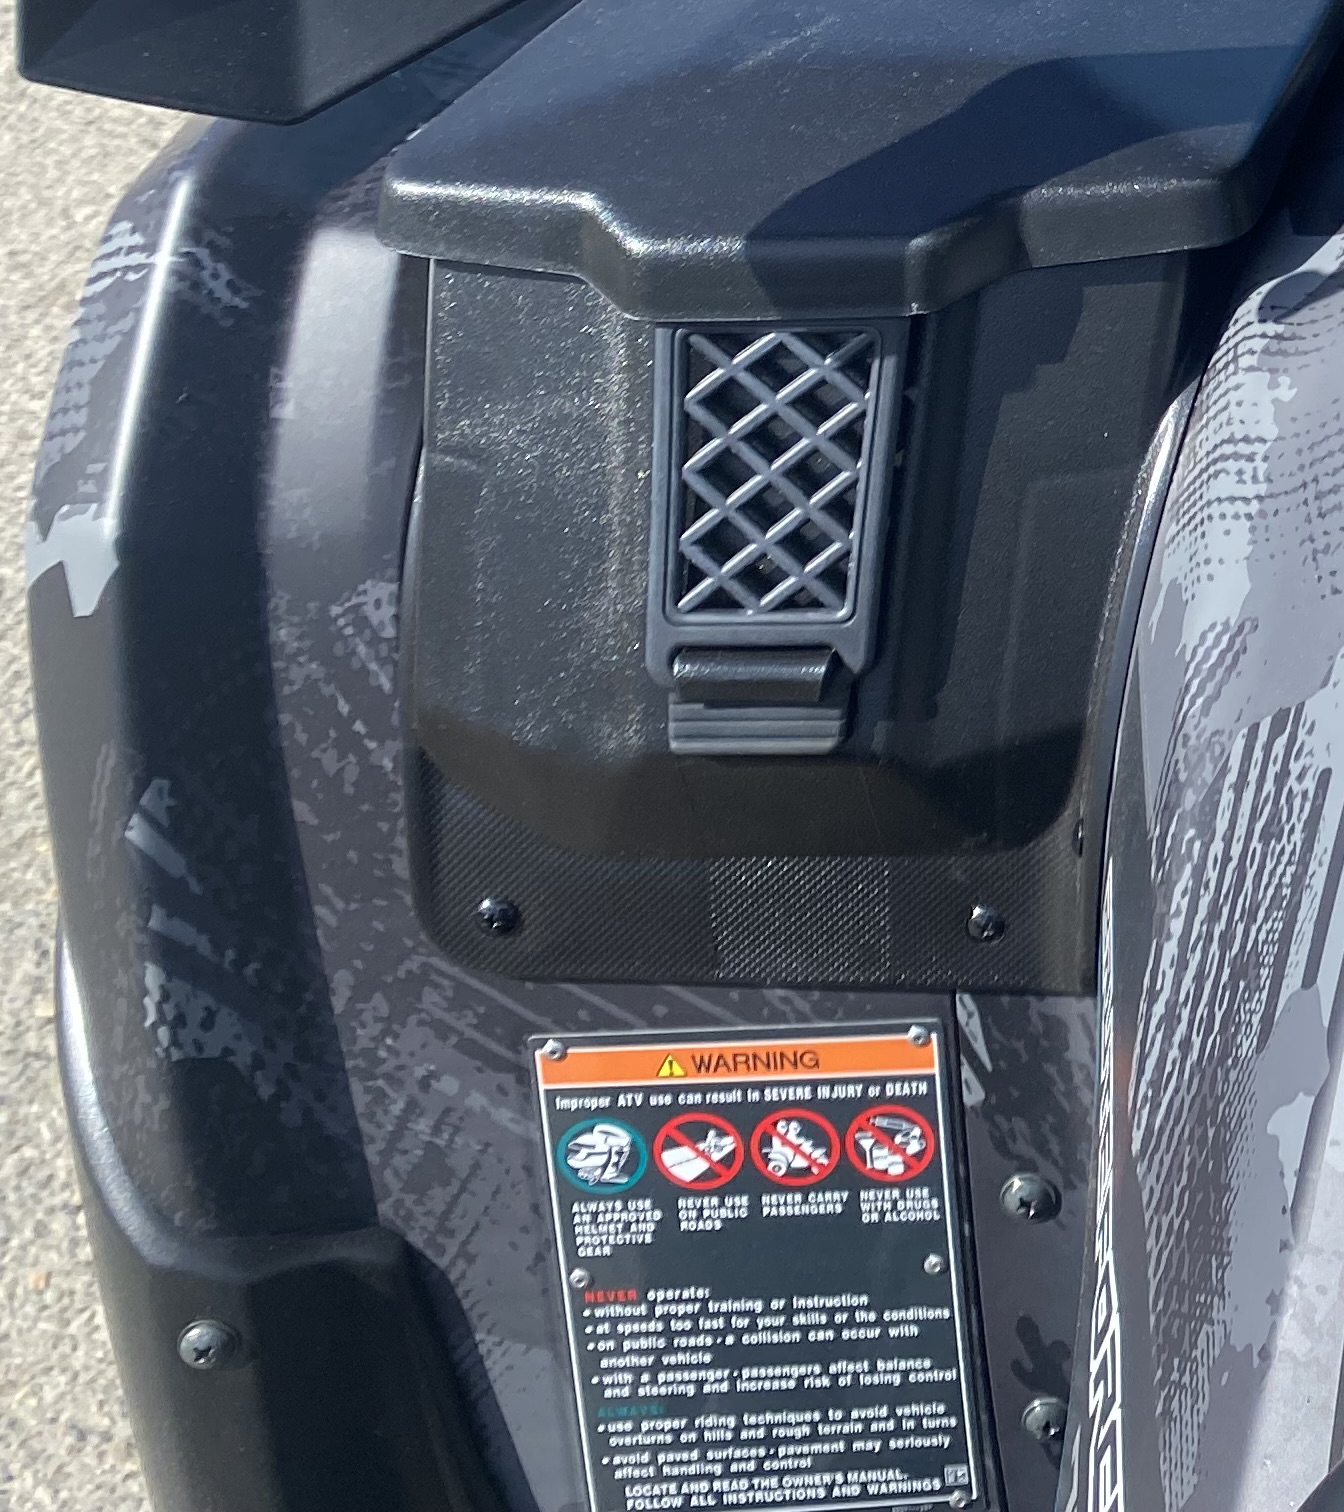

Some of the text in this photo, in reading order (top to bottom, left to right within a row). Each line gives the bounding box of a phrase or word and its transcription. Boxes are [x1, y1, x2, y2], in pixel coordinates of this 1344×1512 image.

[691, 1051, 819, 1072] WARNING
[555, 1081, 927, 1110] Improper ATV use can result in SEVERE INJURY or DEATH
[626, 1478, 941, 1510] FOLLOW ALL INSTRUCTIONS AND WARNINGS
